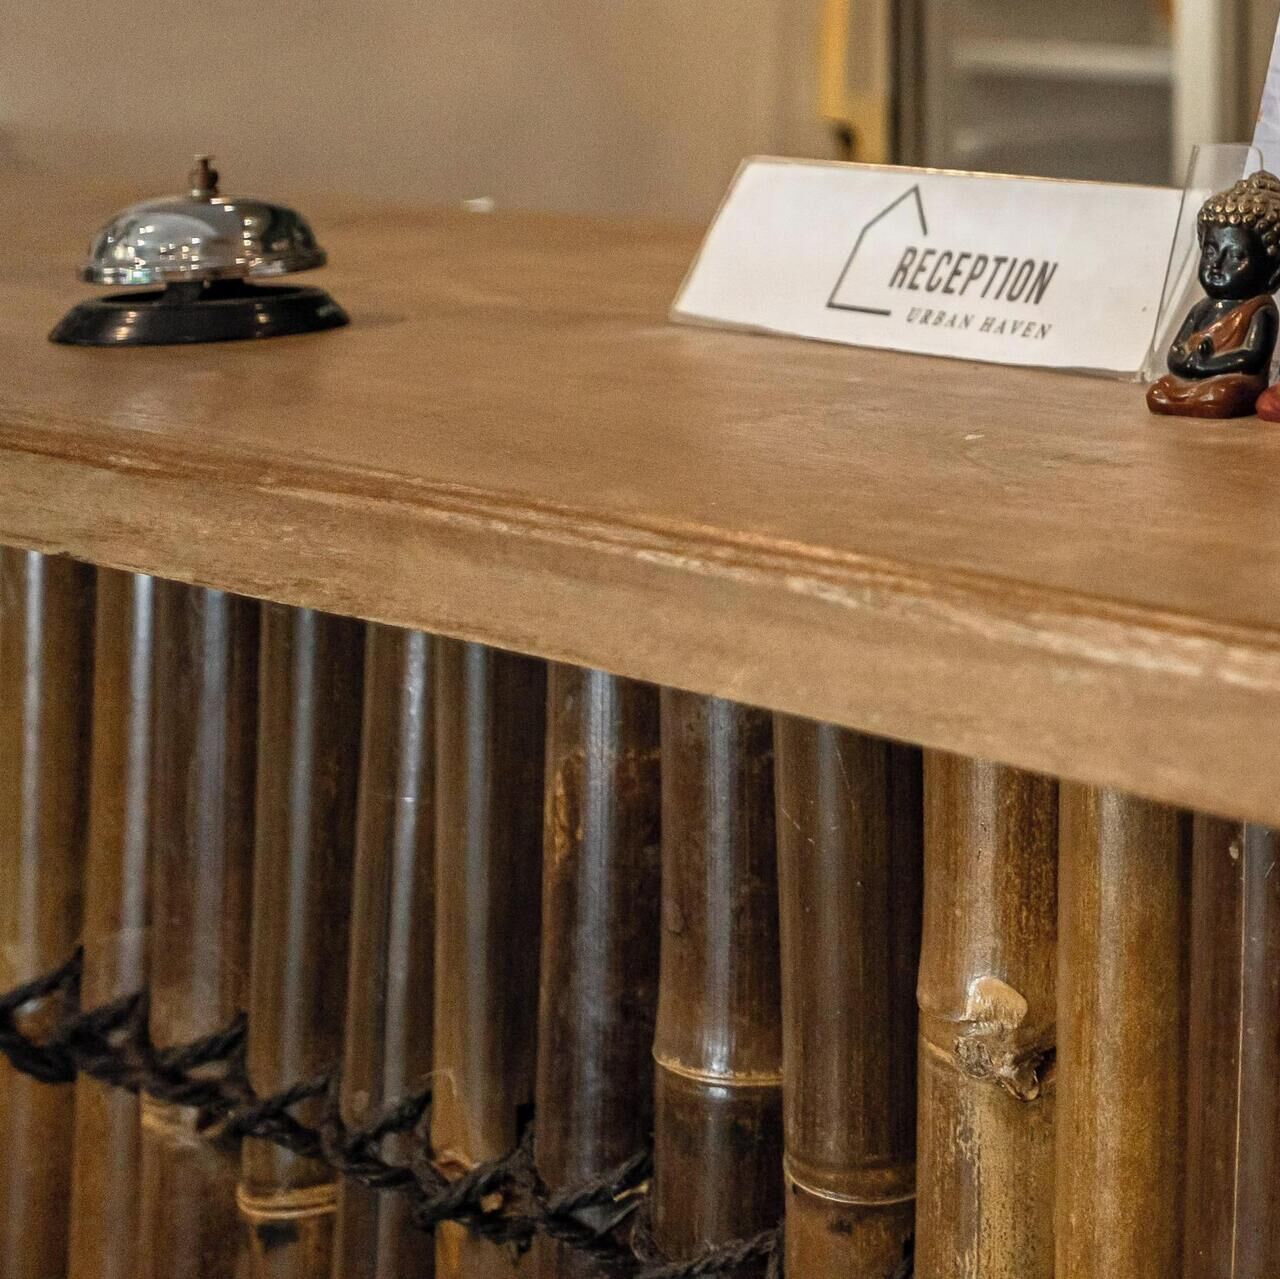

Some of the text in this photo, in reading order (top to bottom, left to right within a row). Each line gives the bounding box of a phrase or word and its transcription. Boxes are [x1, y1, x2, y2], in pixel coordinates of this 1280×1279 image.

[888, 245, 1059, 305] RECEPTION
[906, 306, 1053, 340] URBAN HAVEN
